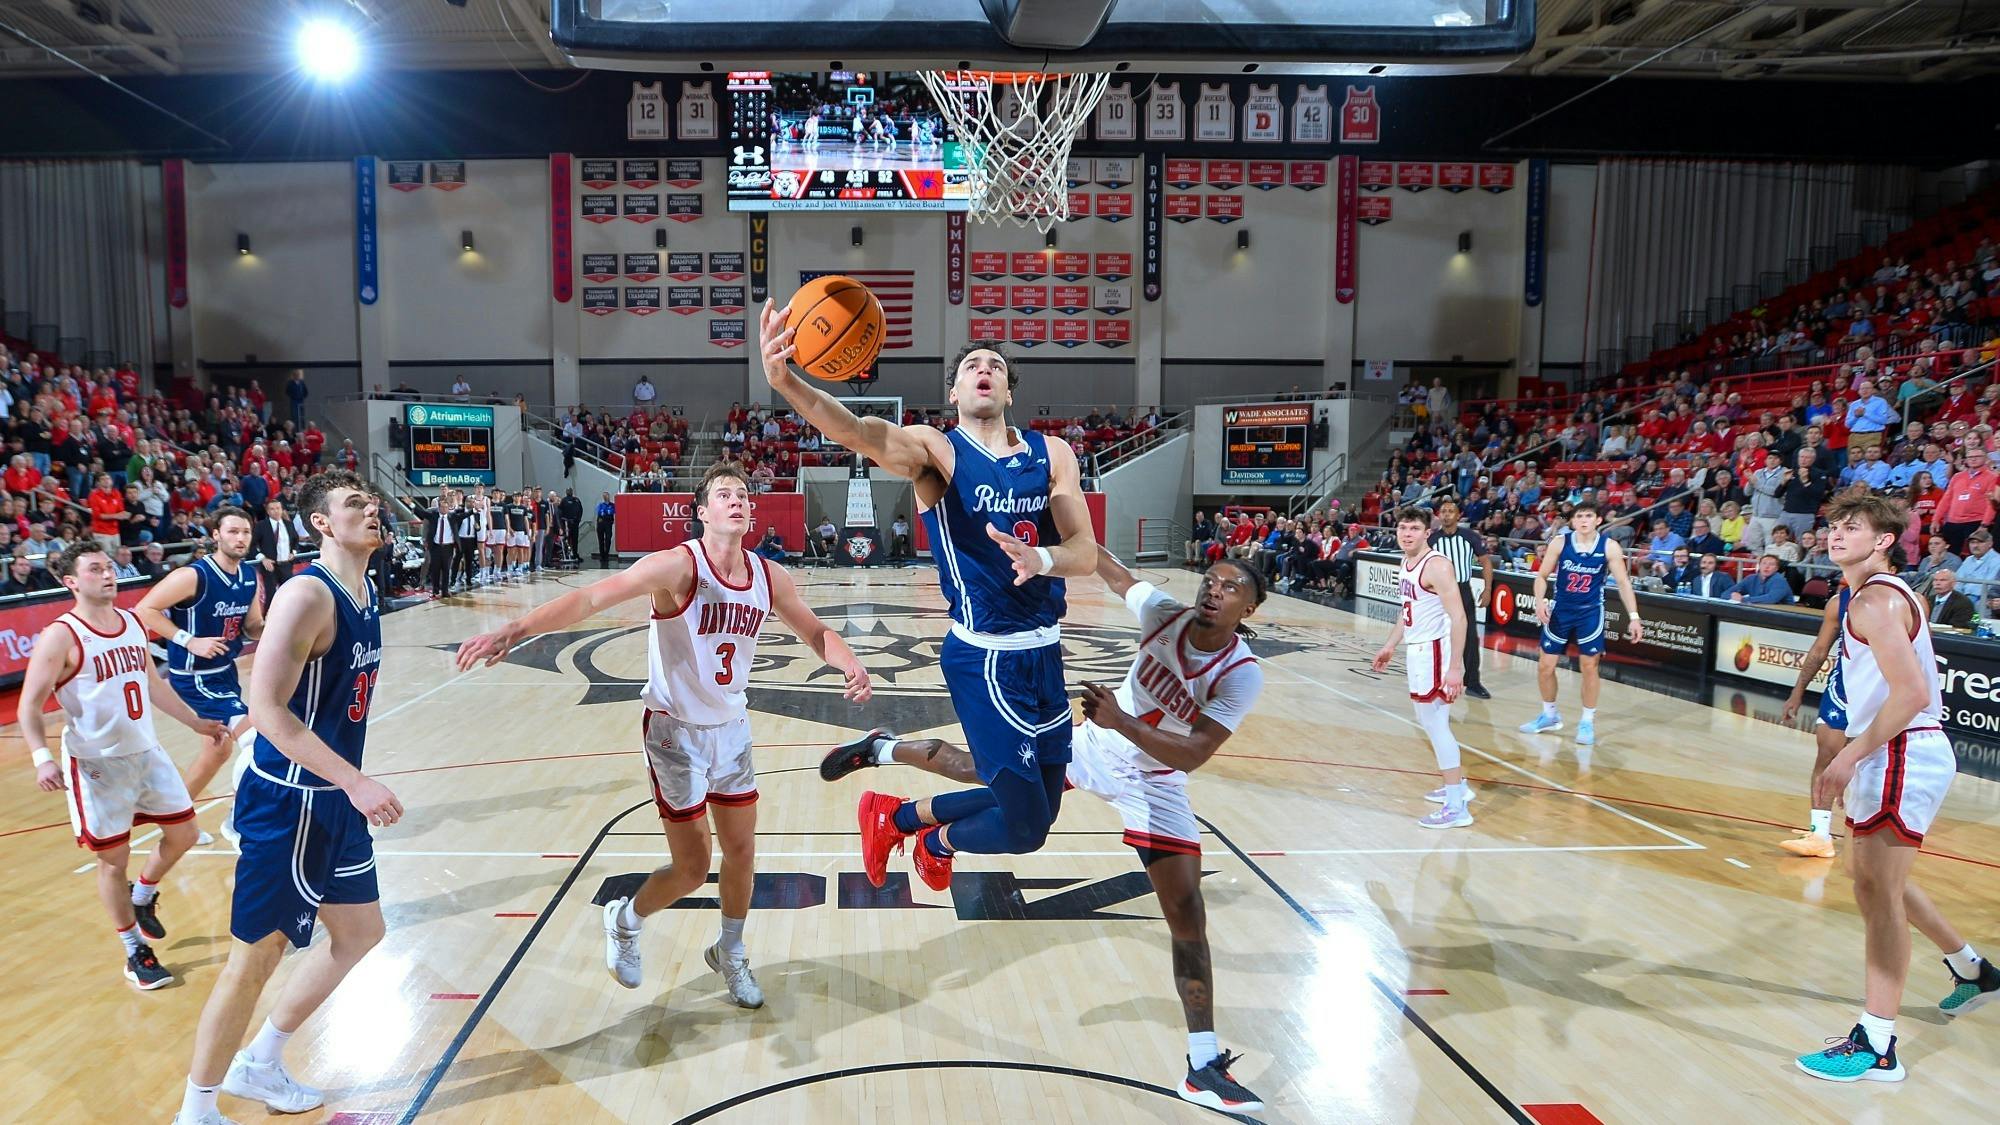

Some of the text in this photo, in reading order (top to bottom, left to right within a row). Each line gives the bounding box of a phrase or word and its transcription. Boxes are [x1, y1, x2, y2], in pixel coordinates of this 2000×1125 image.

[640, 103, 655, 119] 12
[690, 102, 704, 118] 31
[1109, 103, 1124, 119] 10
[1157, 103, 1174, 120] 33
[1209, 104, 1220, 120] 11
[1303, 106, 1320, 122] 42
[1352, 106, 1369, 123] 30
[1255, 112, 1272, 130] D
[878, 170, 893, 183] 52
[772, 201, 802, 211] Cheryle
[823, 201, 837, 209] Joel
[1148, 165, 1157, 273] DAVIDSON
[753, 219, 766, 273] VCU
[951, 215, 962, 282] UMASS
[819, 322, 876, 374] Wilson
[1225, 408, 1308, 423] W WADE ASSOCIATES
[448, 455, 456, 464] 2
[1261, 454, 1269, 464] 2
[1230, 470, 1264, 479] DAVIDSON
[1561, 559, 1604, 575] Richmond
[1566, 572, 1593, 593] 22
[697, 602, 765, 639] DAVIDSON
[1657, 630, 1670, 640] Best
[714, 642, 737, 686] 3
[1136, 653, 1201, 726] DAVIDSON
[123, 681, 144, 721] 0
